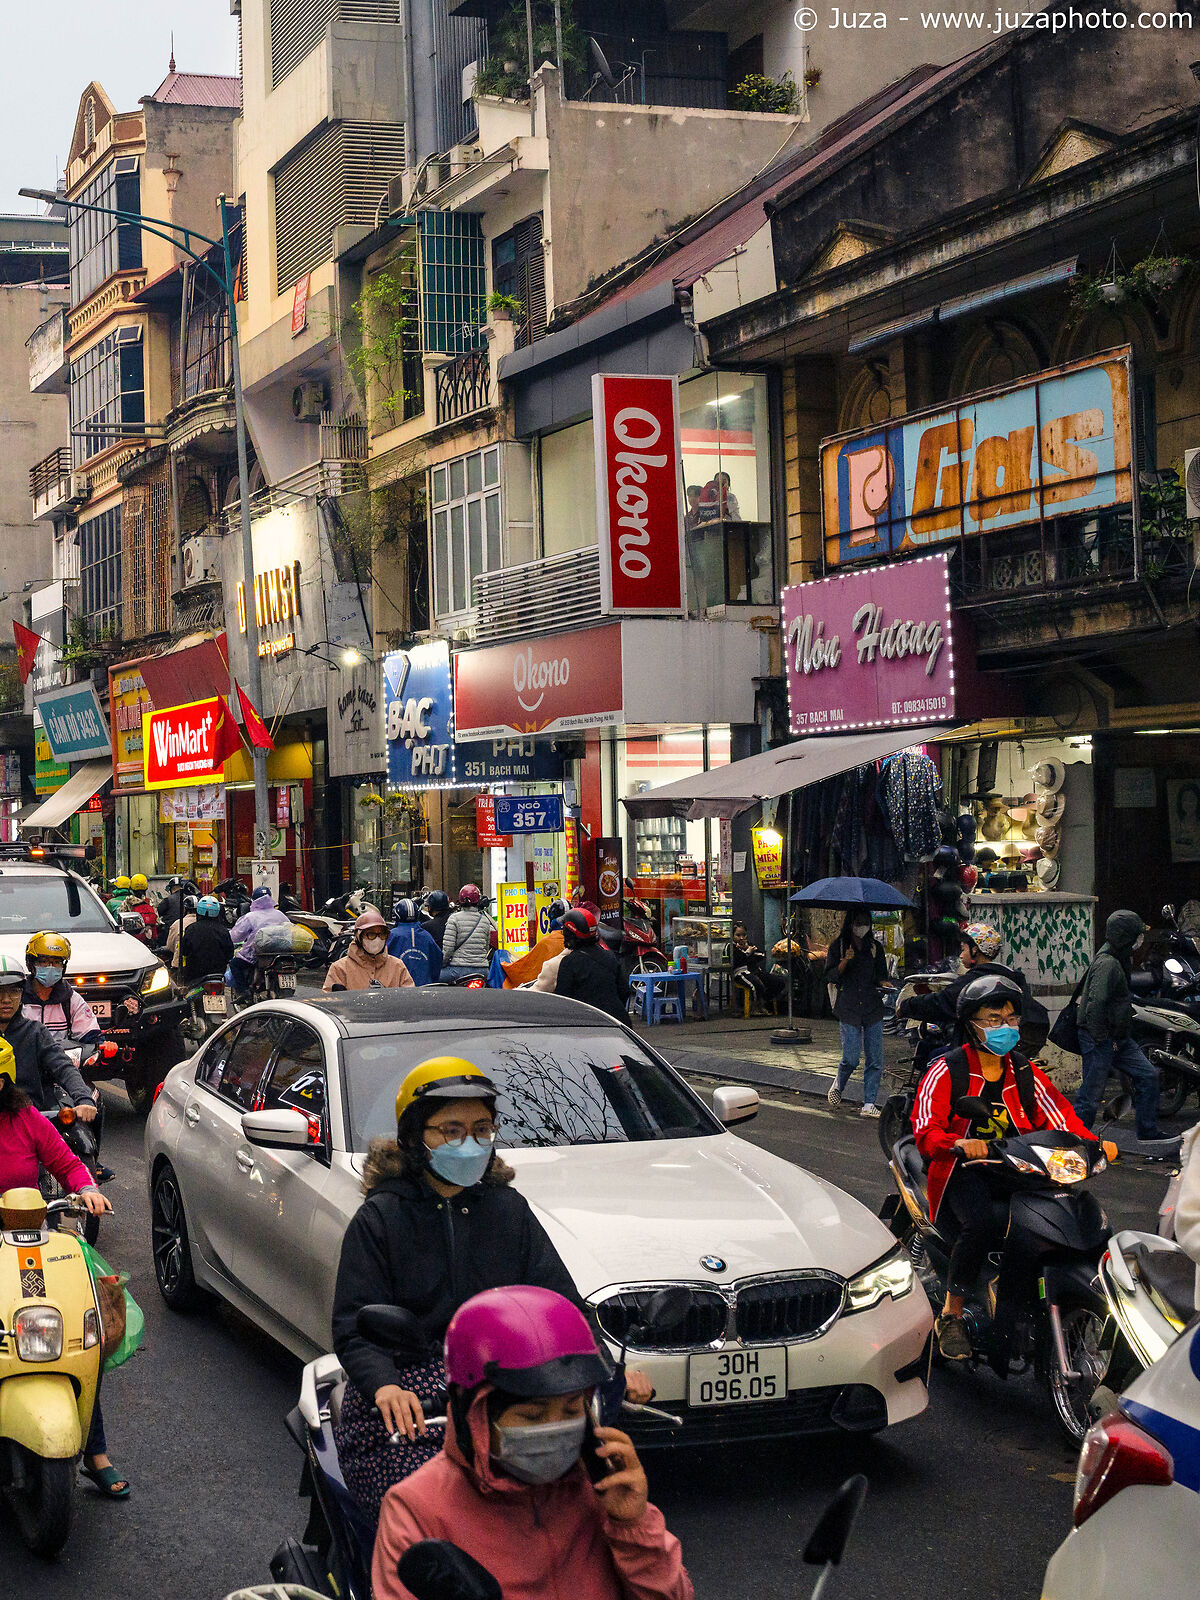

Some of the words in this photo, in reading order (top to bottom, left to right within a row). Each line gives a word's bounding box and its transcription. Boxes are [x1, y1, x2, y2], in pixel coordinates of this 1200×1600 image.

[910, 408, 1105, 534] Gas
[614, 407, 668, 578] Okono
[788, 615, 841, 674] Nón
[514, 647, 570, 692] Okono
[358, 685, 377, 713] taste
[904, 696, 947, 712] 0983415019
[388, 697, 434, 749] BẠC
[796, 713, 810, 725] 357
[810, 712, 828, 726] BẠCH
[830, 709, 844, 721] MAI
[465, 762, 486, 777] 351
[490, 766, 512, 778] BẠCH
[513, 765, 530, 775] MAI
[513, 812, 547, 828] 357
[718, 1352, 759, 1376] 30H
[701, 1375, 776, 1403] 096.05
